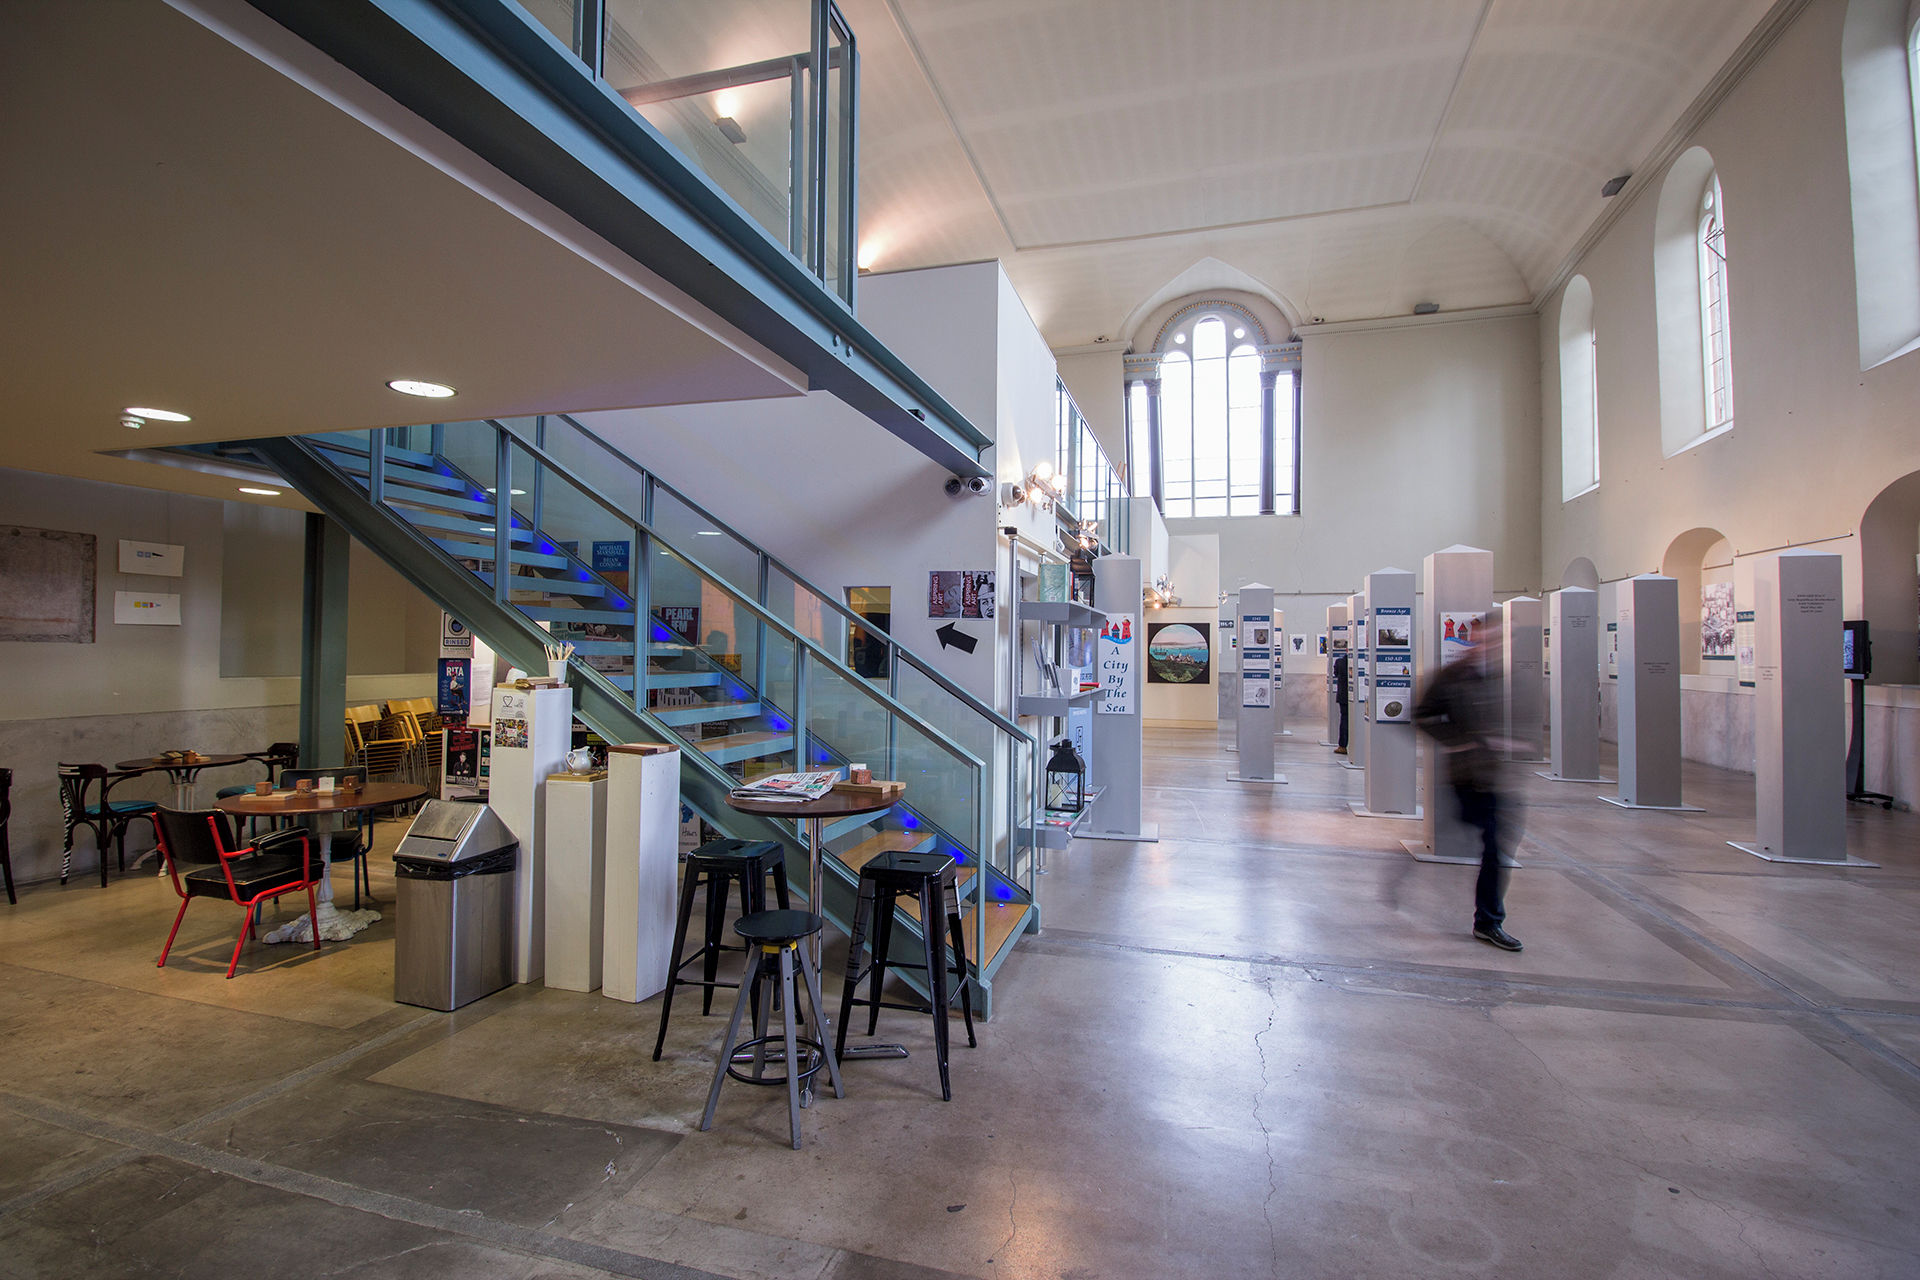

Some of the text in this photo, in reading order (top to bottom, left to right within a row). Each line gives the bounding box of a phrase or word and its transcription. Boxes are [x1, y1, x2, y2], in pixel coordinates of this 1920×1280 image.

[665, 608, 694, 620] PEARL
[1111, 646, 1120, 655] A
[446, 667, 465, 676] RITA
[1103, 660, 1129, 673] City
[1107, 675, 1124, 687] By
[1106, 688, 1127, 698] The
[1105, 703, 1125, 712] Sea
